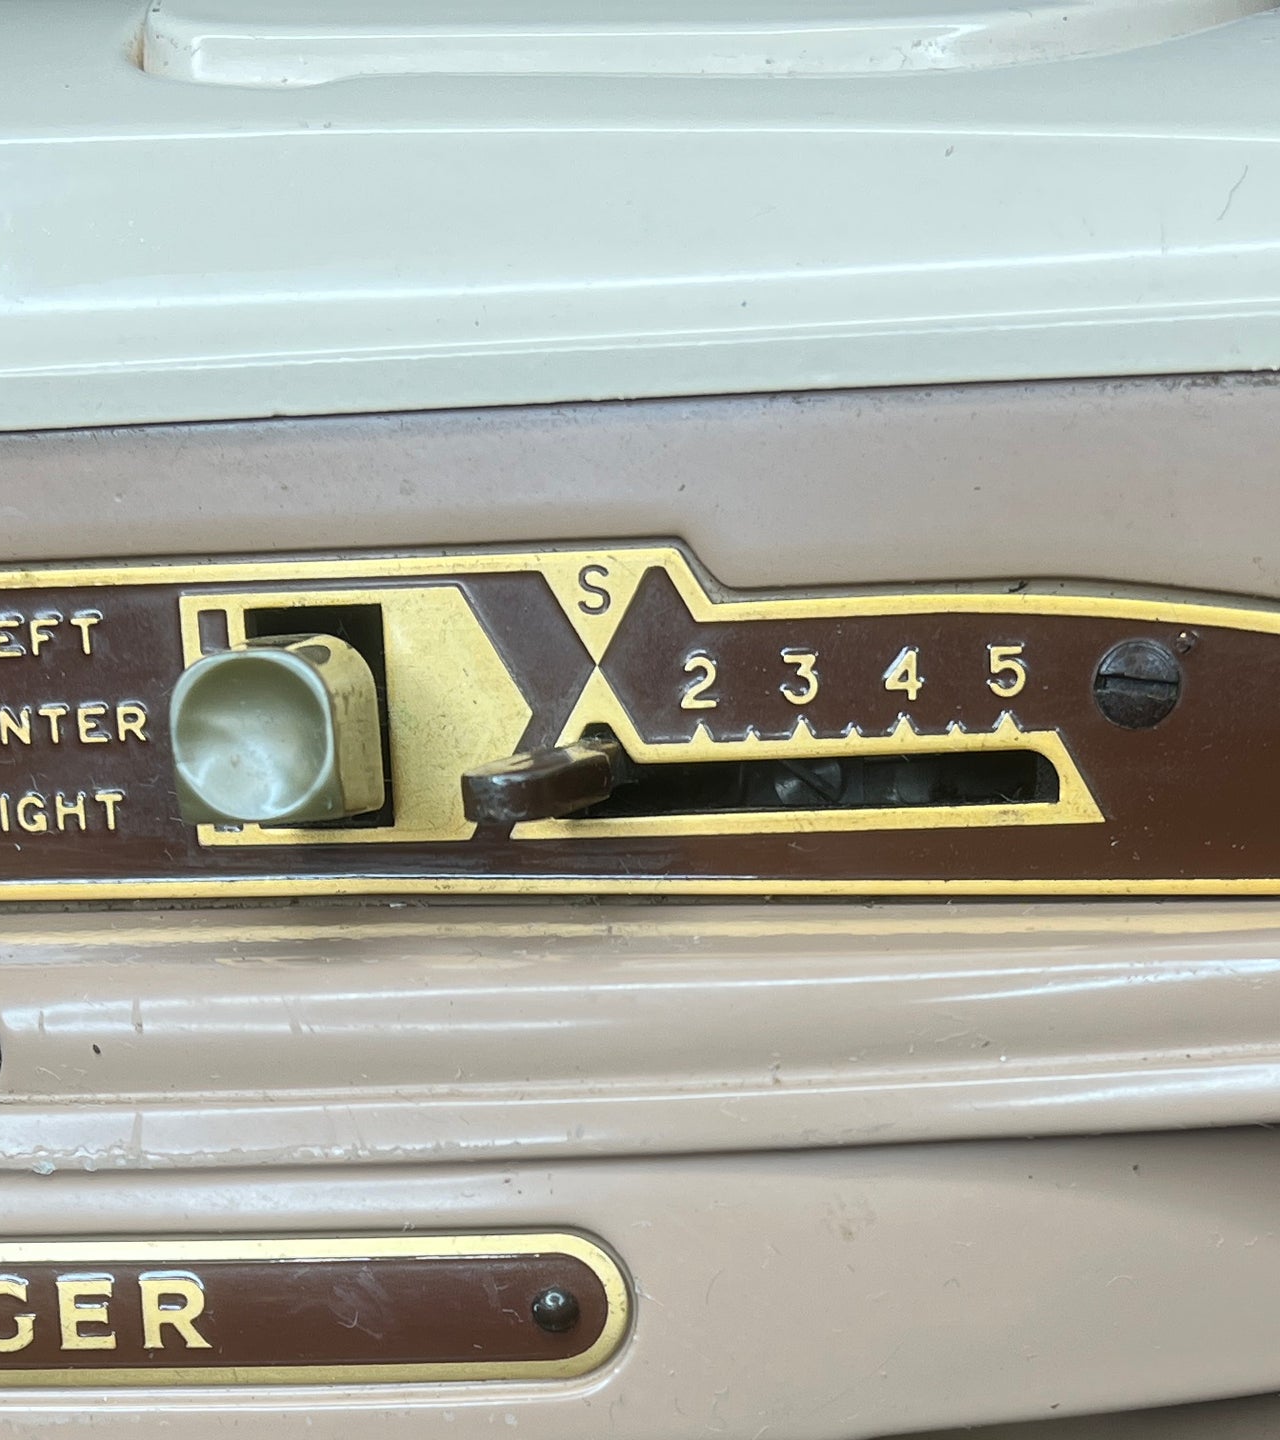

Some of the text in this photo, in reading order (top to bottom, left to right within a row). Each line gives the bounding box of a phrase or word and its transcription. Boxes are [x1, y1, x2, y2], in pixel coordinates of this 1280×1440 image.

[577, 564, 612, 615] S
[680, 644, 1028, 710] 2 3 4 5
